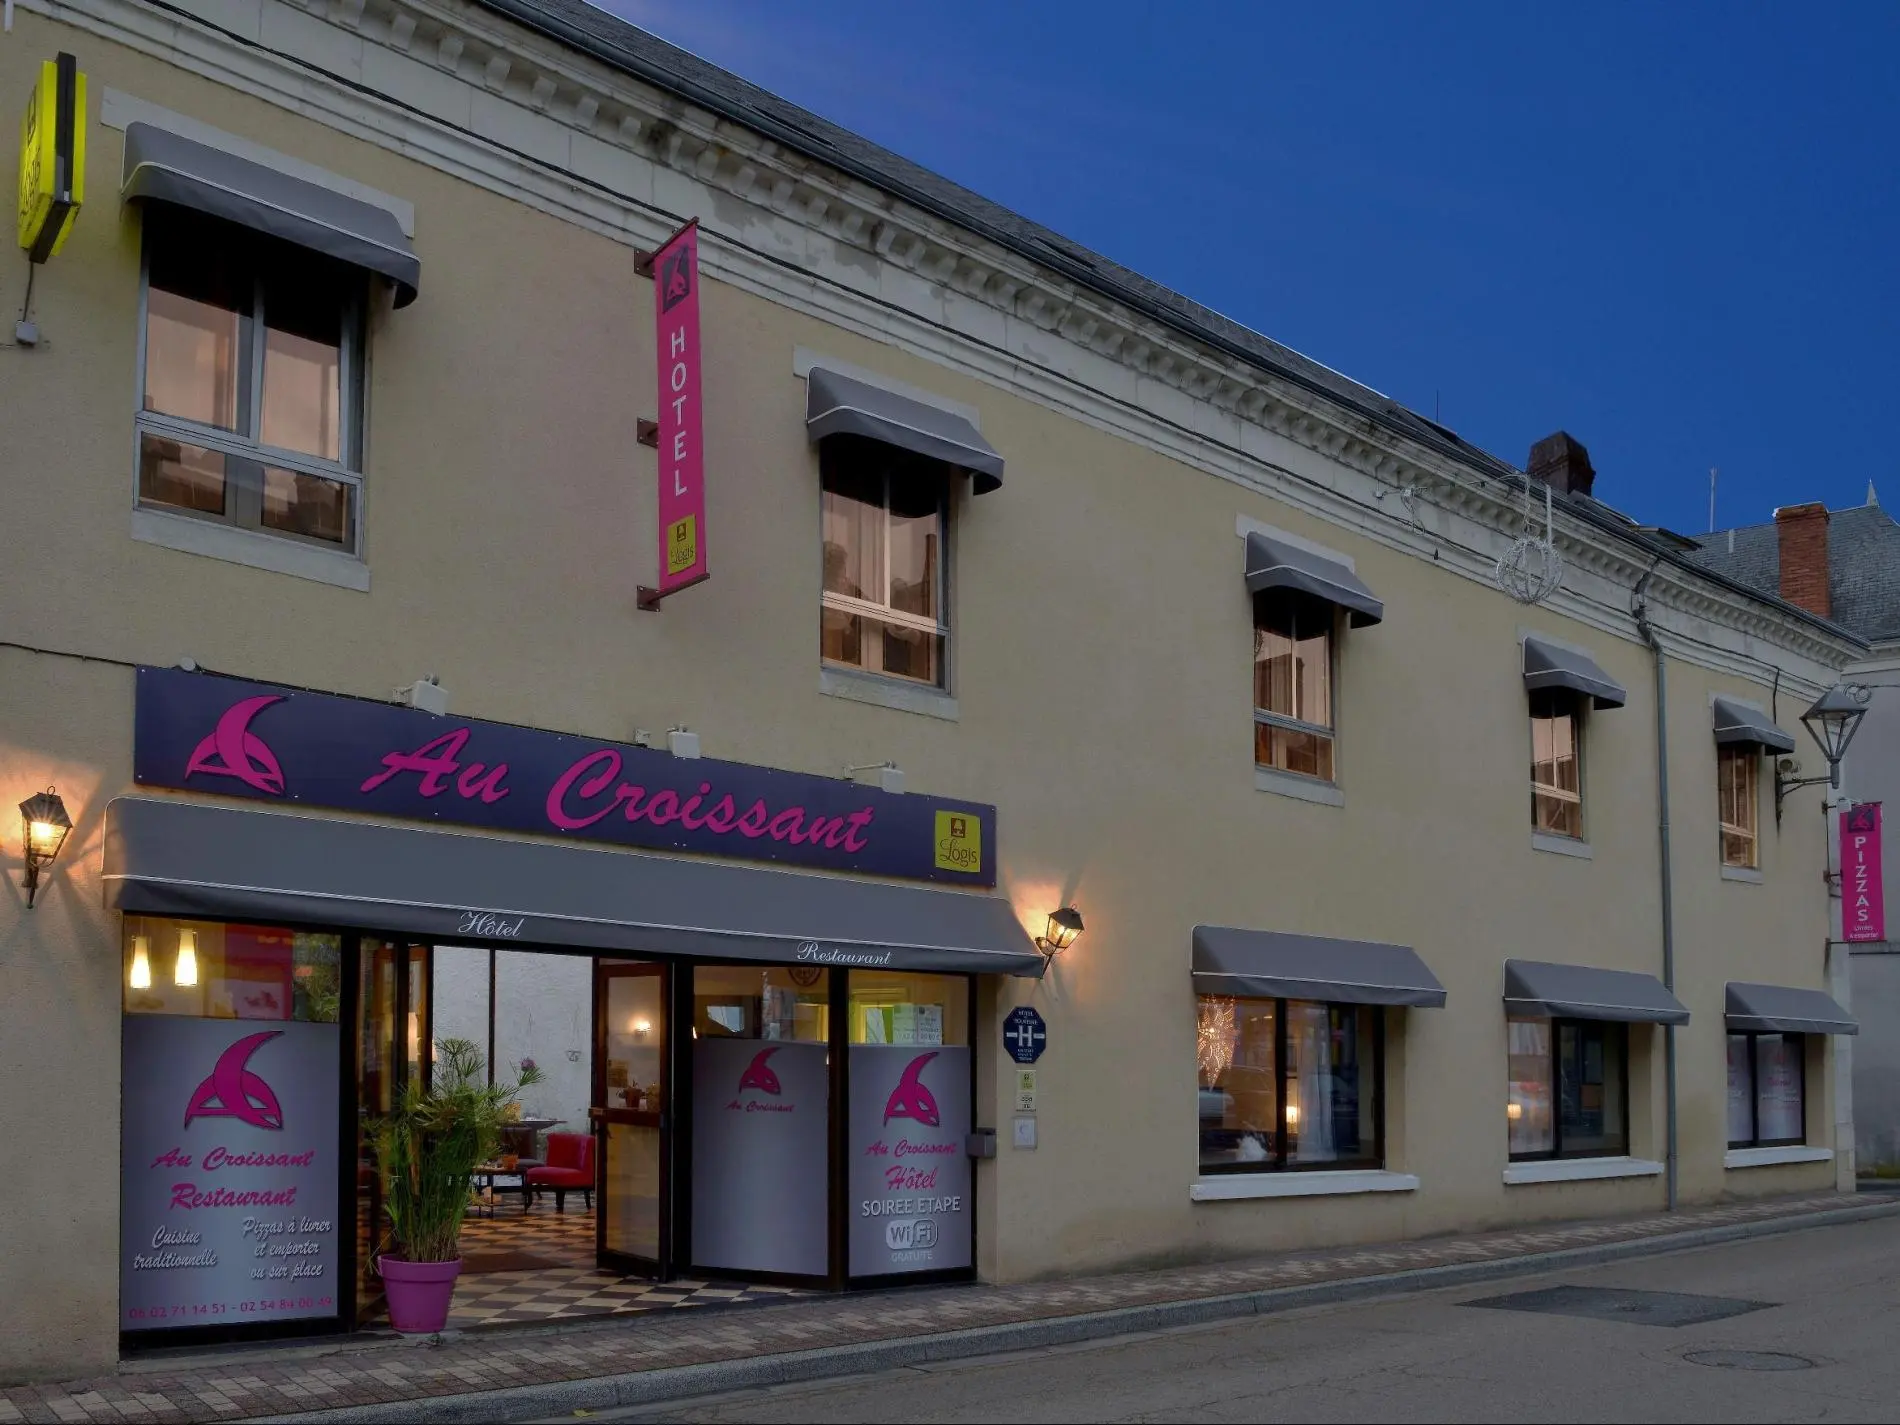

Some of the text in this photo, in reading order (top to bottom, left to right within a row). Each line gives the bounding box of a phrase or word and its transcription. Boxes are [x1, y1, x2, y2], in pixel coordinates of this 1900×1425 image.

[671, 326, 688, 497] HOTEL
[360, 727, 875, 853] Au Croissant
[940, 838, 977, 868] Logis
[1855, 836, 1869, 921] PIZZAS
[457, 911, 526, 938] Hôtel
[796, 941, 895, 966] Restaurant
[1019, 1025, 1032, 1047] H
[150, 1147, 315, 1171] Au Croissant
[864, 1138, 957, 1158] Au Croissant
[885, 1165, 938, 1190] Hôtel
[168, 1183, 298, 1210] Restaurant
[862, 1196, 961, 1217] SOIREE ETAPE
[151, 1225, 201, 1249] Cuisine
[242, 1215, 332, 1241] Pizzas à livrer
[889, 1223, 933, 1243] WiFi
[133, 1249, 218, 1270] traditionnelle
[254, 1240, 320, 1260] et emporter
[250, 1260, 324, 1282] ou sur place
[172, 1305, 186, 1316] 71
[192, 1304, 207, 1314] 14
[212, 1303, 226, 1313] 51
[240, 1301, 256, 1312] 02
[260, 1300, 274, 1310] 54
